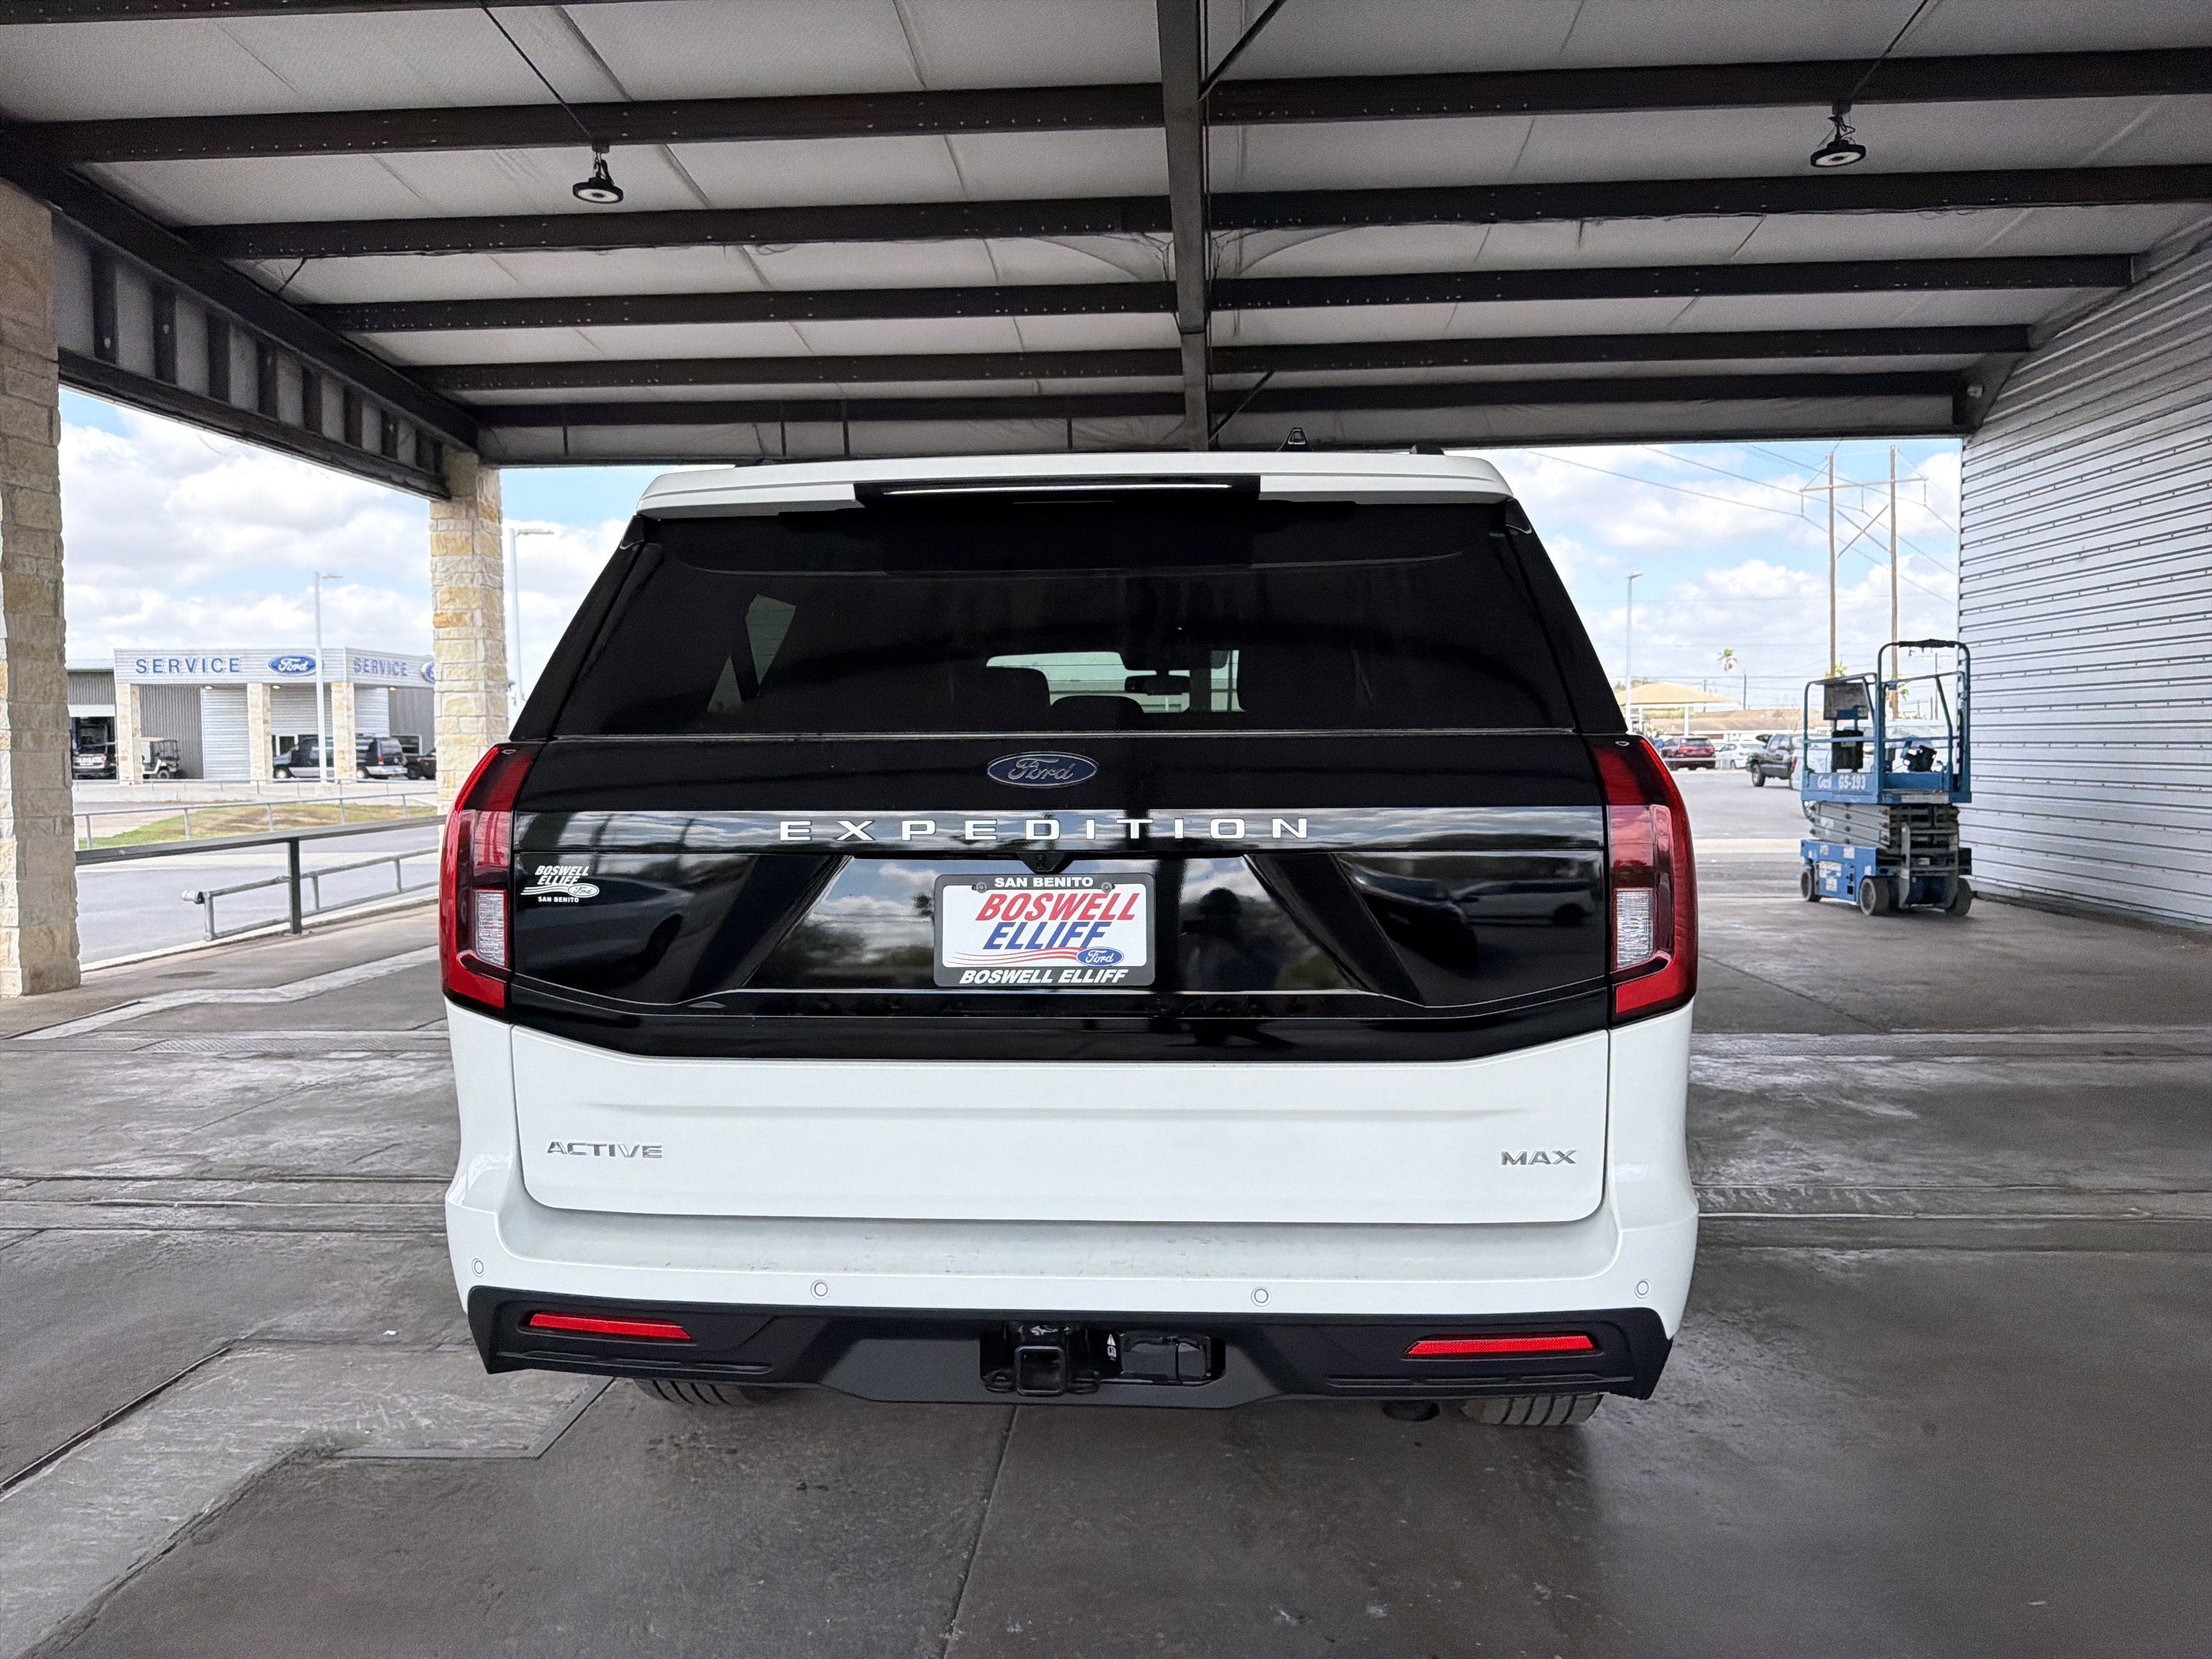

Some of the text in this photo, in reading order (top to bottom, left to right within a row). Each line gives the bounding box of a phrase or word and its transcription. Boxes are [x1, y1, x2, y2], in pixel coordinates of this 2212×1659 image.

[135, 658, 241, 674] SERVICE
[278, 659, 308, 672] Ford
[354, 657, 408, 676] SERVICE
[1008, 758, 1076, 780] Ford
[779, 817, 1308, 842] EXPEDITION
[534, 865, 590, 876] BOSWELL
[537, 876, 580, 885] ELLIFF
[994, 876, 1093, 888] SAN BENITO
[975, 893, 1141, 921] BOSWELL
[983, 921, 1113, 950] ELLIFF
[1085, 949, 1114, 964] Ford
[960, 968, 1130, 984] BOSWELL ELLIFF
[546, 1141, 663, 1159] ACTIVE
[1501, 1149, 1577, 1165] MAX
